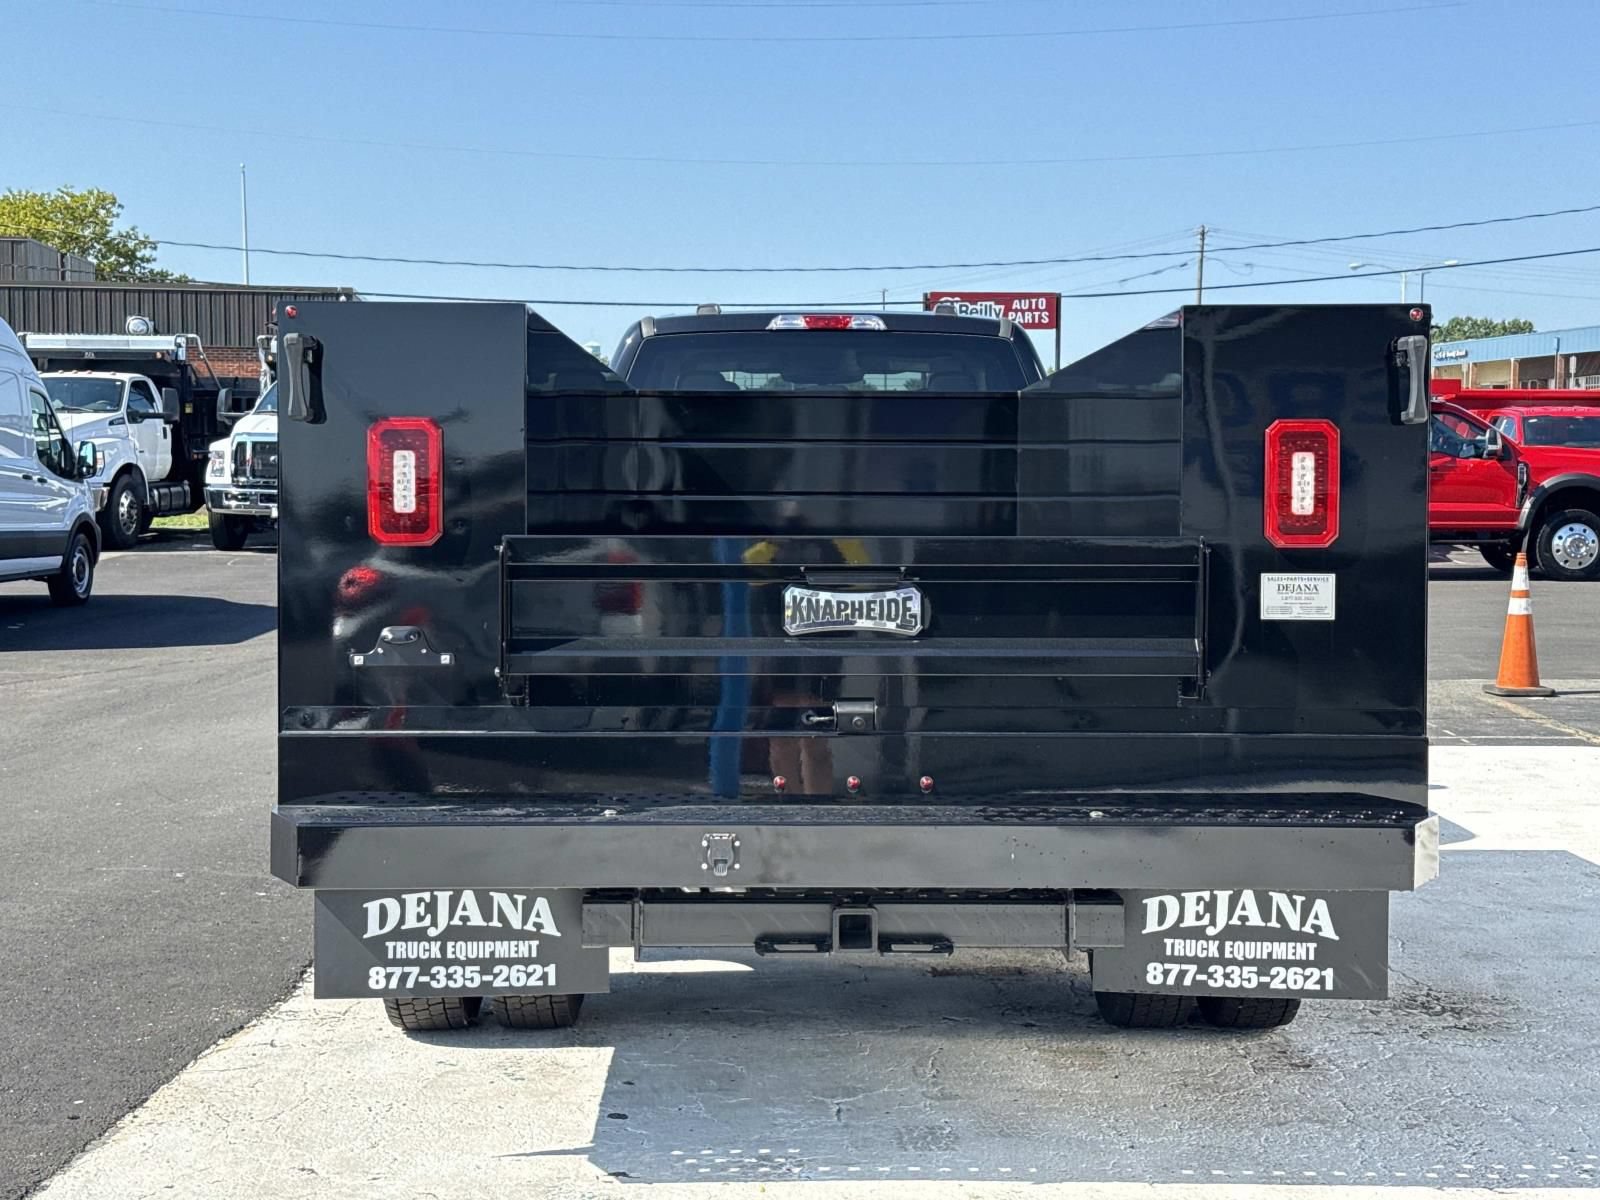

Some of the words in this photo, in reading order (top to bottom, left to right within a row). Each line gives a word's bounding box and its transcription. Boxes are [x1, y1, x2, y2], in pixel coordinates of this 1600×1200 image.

[1012, 298, 1046, 310] AUTO
[1008, 311, 1049, 324] PARTS
[1277, 583, 1319, 593] DEJANA
[790, 594, 917, 628] KNAPHEIDE
[362, 889, 562, 939] DEJANA
[1141, 889, 1340, 941] DEJANA
[385, 941, 441, 959] TRUCK
[447, 940, 540, 961] EQUIPMENT
[1164, 938, 1219, 958] TRUCK
[1224, 941, 1317, 961] EQUIPMENT
[368, 963, 557, 990] 877-335-2621
[1146, 962, 1335, 991] 877-335-2621
